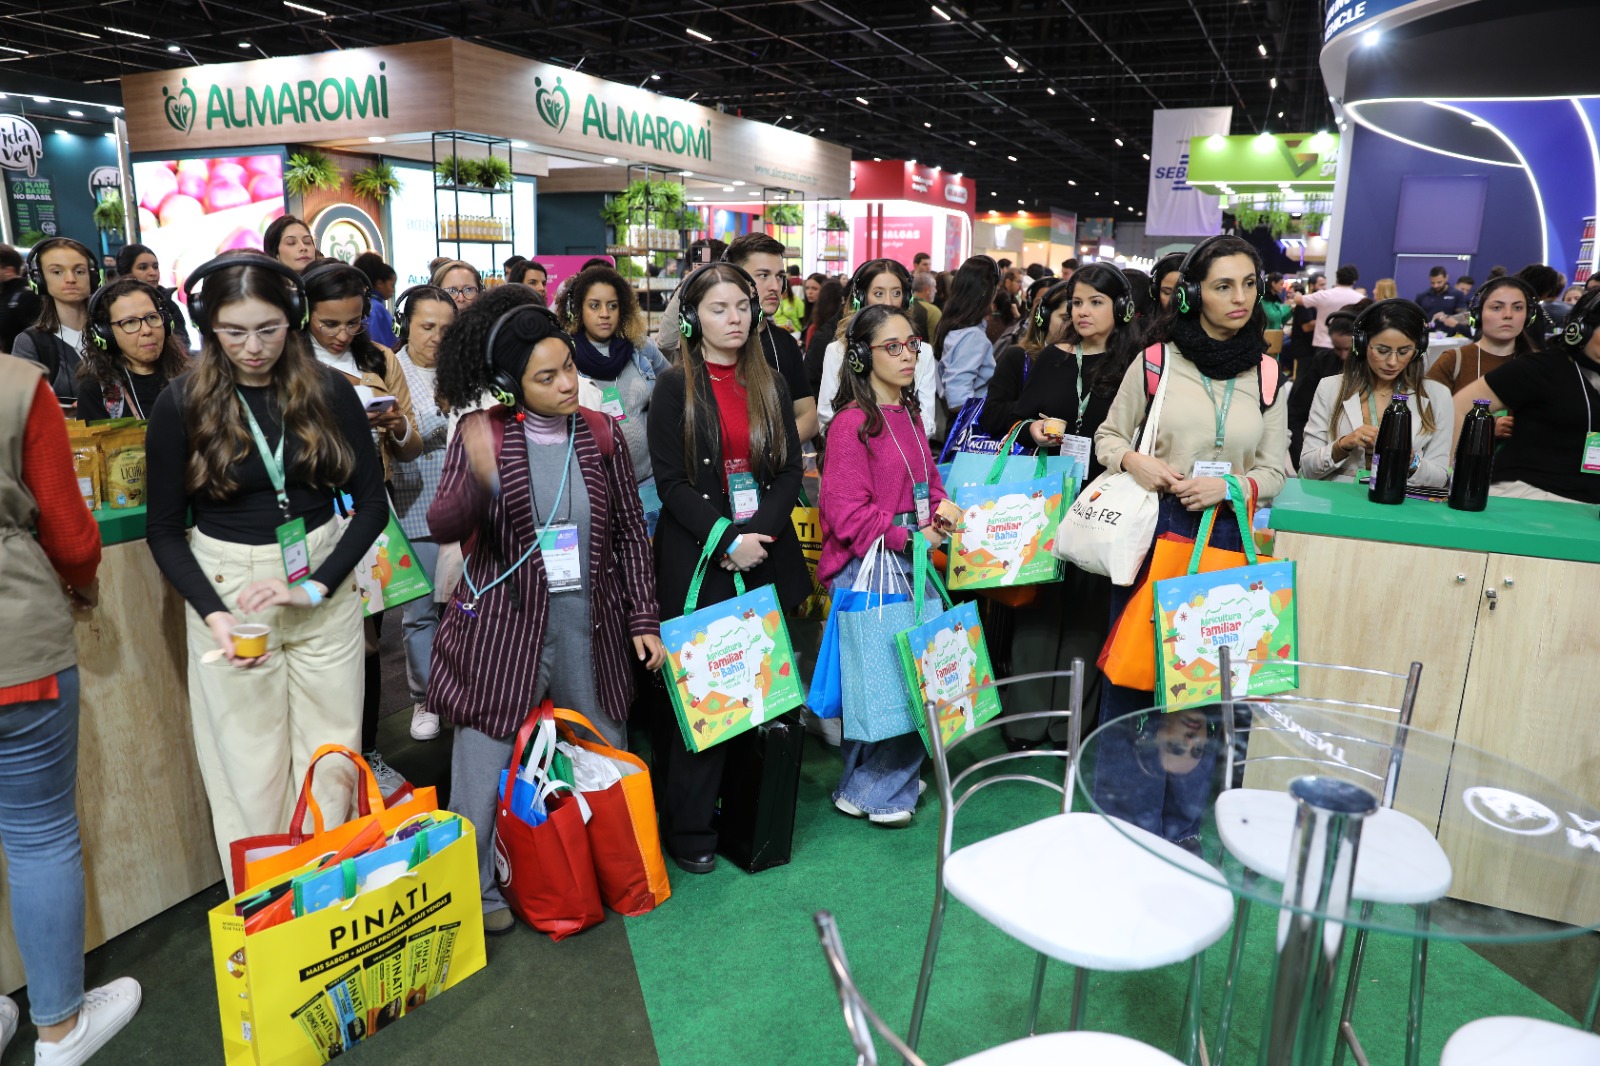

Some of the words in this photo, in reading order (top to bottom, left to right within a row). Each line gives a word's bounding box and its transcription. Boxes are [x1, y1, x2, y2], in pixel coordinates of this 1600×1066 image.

[0, 122, 31, 148] ida
[26, 193, 52, 201] BRASIL
[986, 522, 1022, 533] Familiar
[987, 515, 1022, 525] Agricultura
[995, 531, 1018, 540] Bahia
[1200, 612, 1242, 627] Agricultura
[1200, 621, 1242, 638] Familiar
[1212, 633, 1239, 646] Bahia
[706, 642, 742, 661] Agricultura
[708, 650, 744, 672] Familiar
[720, 661, 745, 678] Bahia
[330, 882, 427, 950] PINATI
[305, 964, 325, 977] MAIS
[324, 953, 349, 968] SABOR
[355, 940, 378, 955] MUITA
[411, 911, 426, 924] MAIS
[426, 897, 448, 915] VENDAS
[420, 938, 430, 974] PINATI
[392, 953, 402, 997] PINATI
[346, 978, 364, 1013] PINATI
[312, 1003, 334, 1033] PINATI
